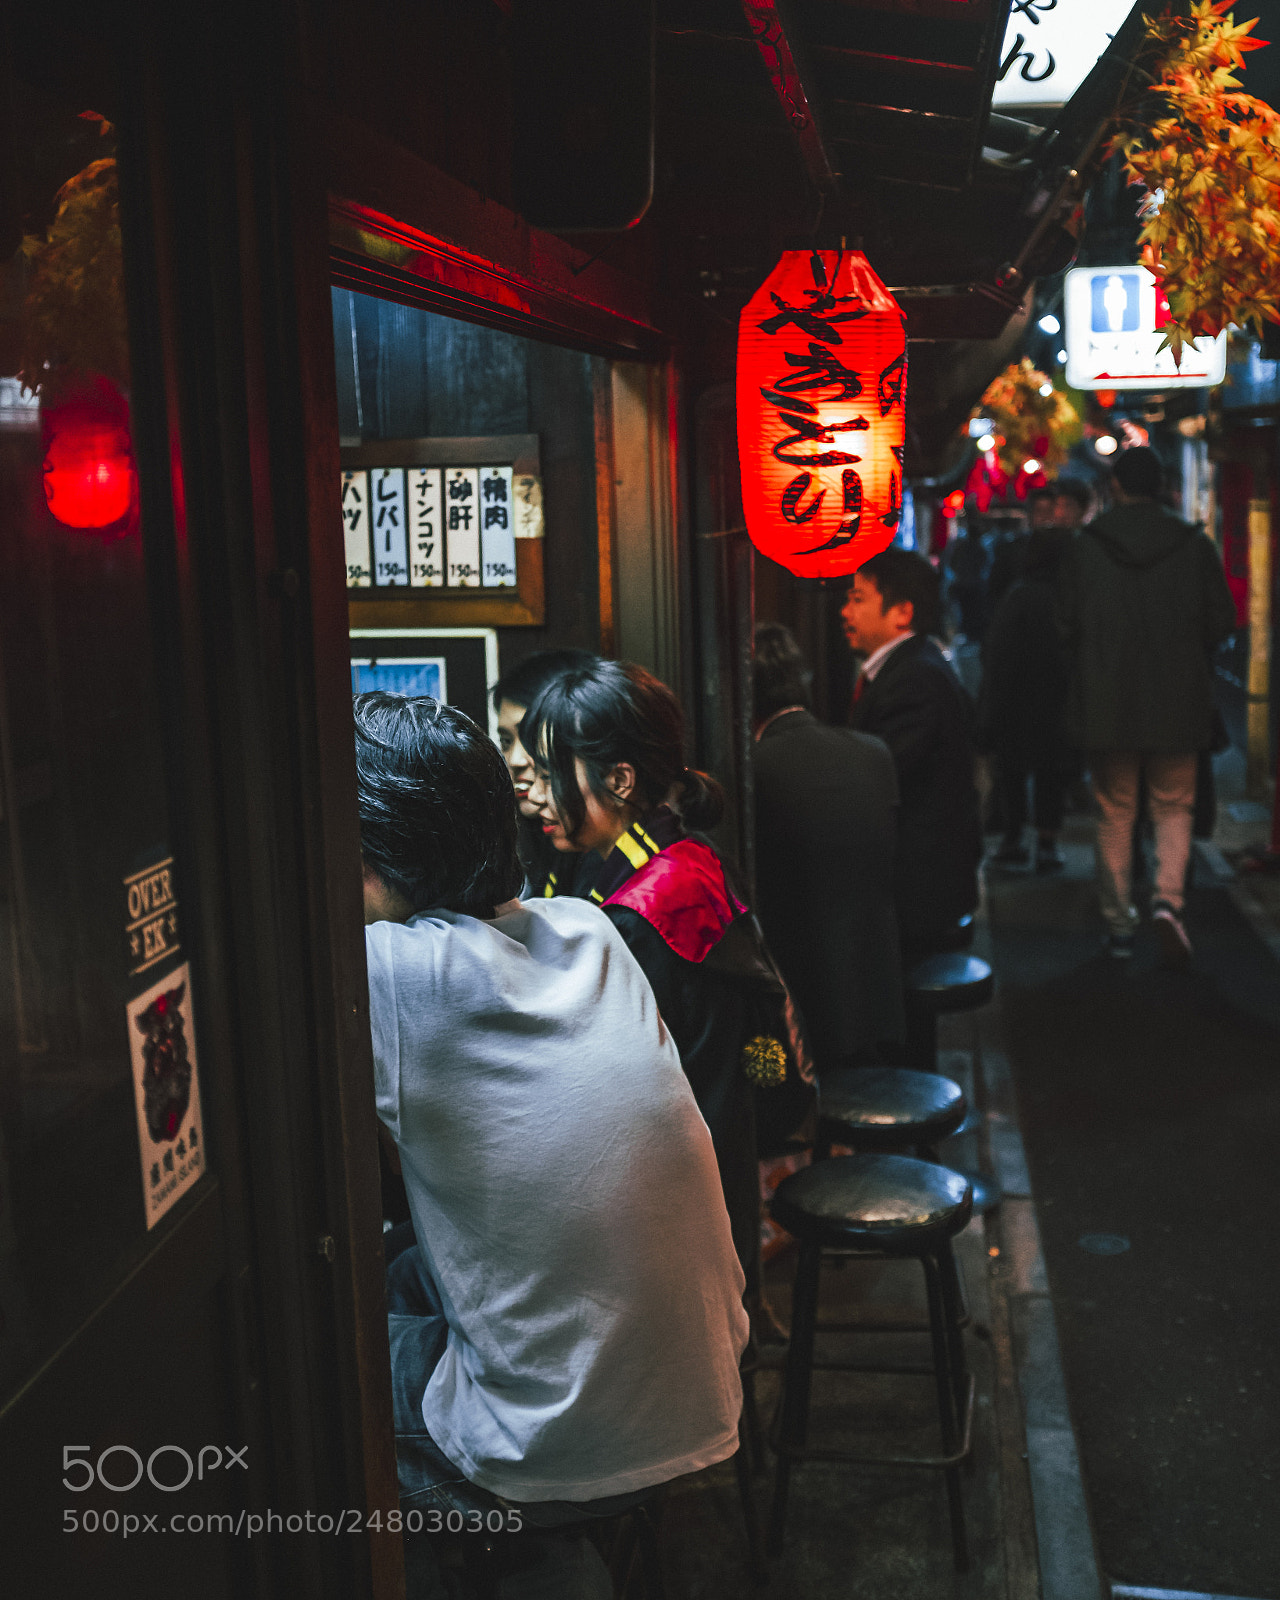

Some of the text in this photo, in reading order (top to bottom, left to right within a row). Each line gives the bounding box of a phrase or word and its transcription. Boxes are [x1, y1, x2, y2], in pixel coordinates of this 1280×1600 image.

[377, 478, 399, 552] レバー
[416, 479, 434, 558] ナンコツ
